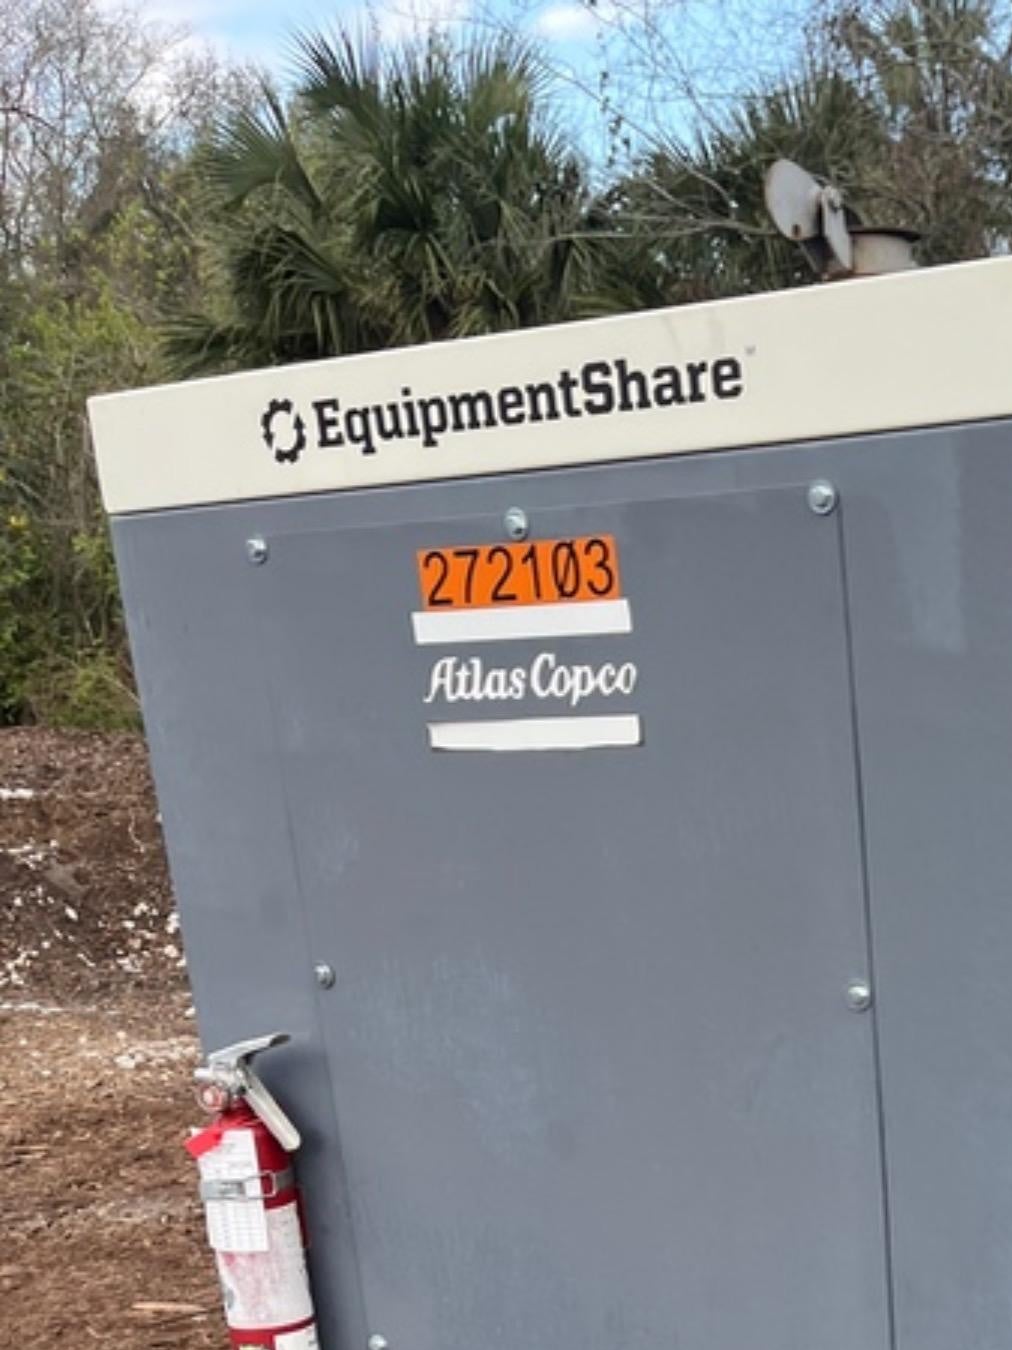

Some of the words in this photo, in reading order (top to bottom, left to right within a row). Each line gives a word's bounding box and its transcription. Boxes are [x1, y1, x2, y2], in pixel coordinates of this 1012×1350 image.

[313, 355, 743, 455] EquipmentShare
[422, 539, 615, 607] 272103
[422, 655, 526, 704] Atlas
[529, 652, 638, 707] Copco
